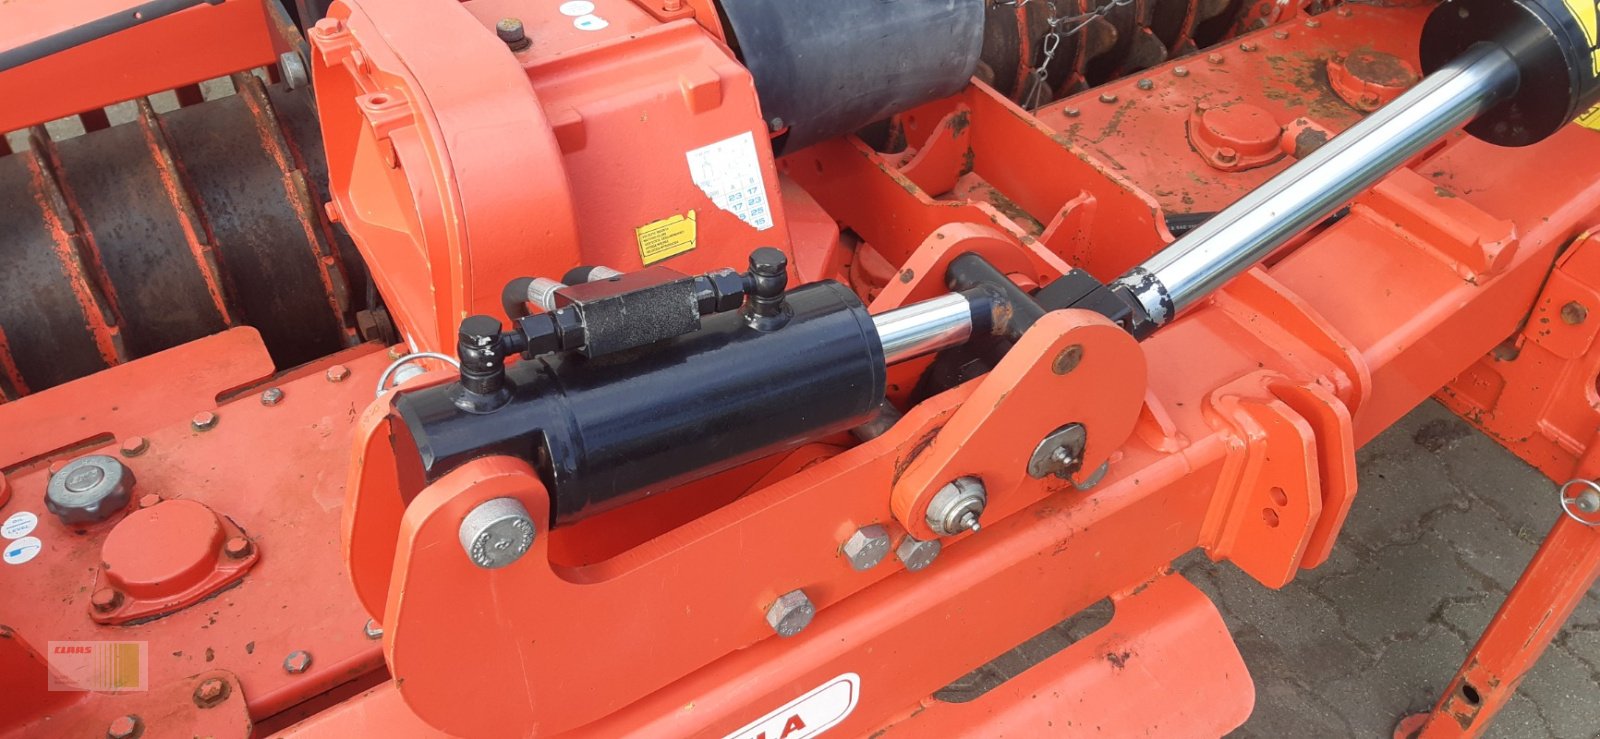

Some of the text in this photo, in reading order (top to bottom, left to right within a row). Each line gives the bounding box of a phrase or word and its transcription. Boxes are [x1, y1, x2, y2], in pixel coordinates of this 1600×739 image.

[728, 192, 743, 202] 23
[747, 186, 757, 195] 17
[732, 202, 743, 211] 17
[750, 206, 764, 216] 25
[754, 217, 766, 226] 15
